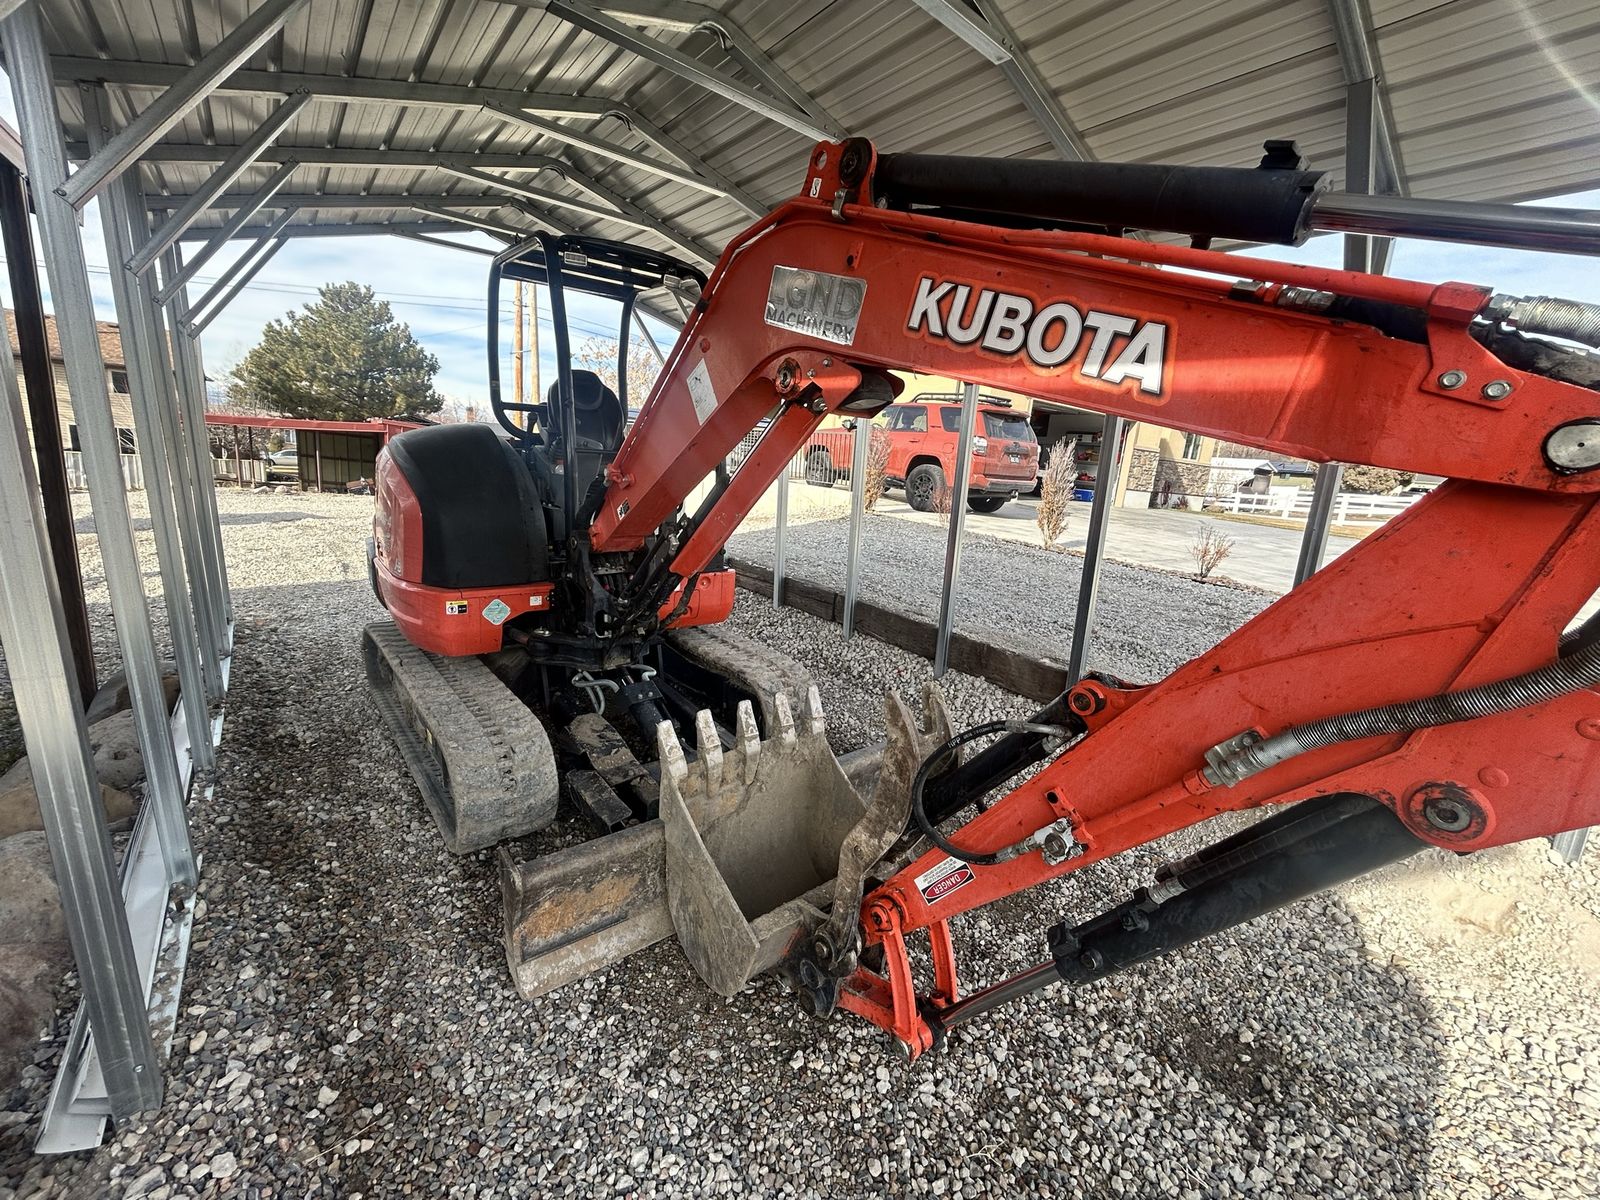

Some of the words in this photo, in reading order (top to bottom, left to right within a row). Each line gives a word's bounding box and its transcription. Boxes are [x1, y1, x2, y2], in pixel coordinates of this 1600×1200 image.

[766, 307, 855, 341] MACHINERY
[908, 277, 1167, 394] KUBOTA
[932, 873, 961, 894] DANGER
